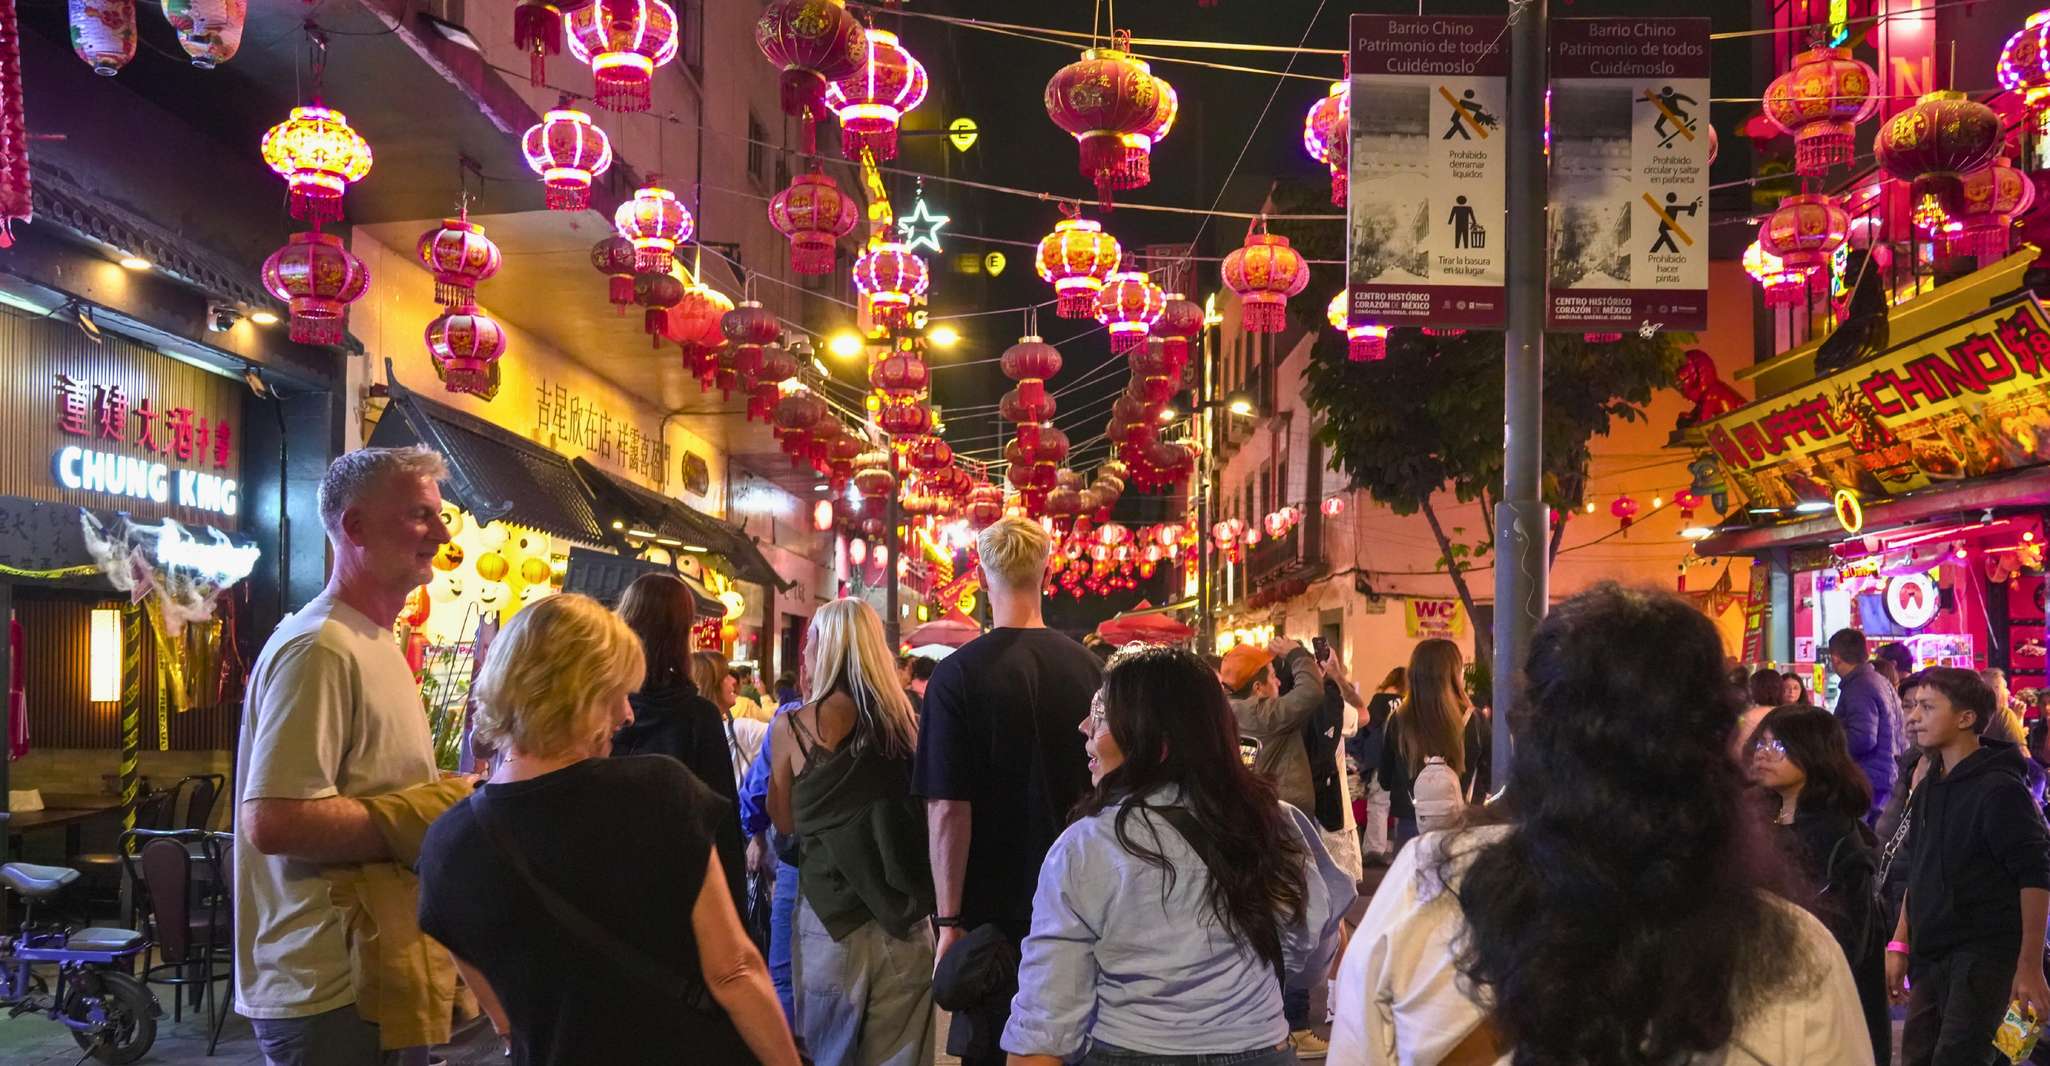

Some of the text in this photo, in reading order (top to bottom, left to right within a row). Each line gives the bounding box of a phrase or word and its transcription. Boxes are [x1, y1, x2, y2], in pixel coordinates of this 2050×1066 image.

[1388, 21, 1474, 35] Barrio Chino
[1589, 24, 1676, 37] Barrio Chino
[1358, 38, 1500, 54] Patrimonio de todos
[1559, 42, 1704, 56] Patrimonio de todos
[1386, 58, 1475, 74] Cuidémoslo
[1590, 60, 1675, 75] Cuidémoslo
[958, 124, 968, 140] E
[1449, 150, 1488, 160] Prohibido
[1652, 156, 1692, 165] Prohibido
[1643, 166, 1700, 177] circular y saltar
[1662, 176, 1695, 185] patineta
[990, 256, 998, 267] E
[1438, 256, 1491, 265] Tirar la basura
[1647, 255, 1687, 264] Prohibido
[1443, 267, 1485, 277] en su lugar
[1656, 264, 1679, 273] hacer
[1655, 275, 1681, 285] pintas
[1354, 292, 1430, 301] CENTRO HISTÓRICO
[1555, 296, 1632, 306] CENTRO HISTÓRICO
[1354, 300, 1390, 309] CORAZÓN
[1401, 301, 1430, 310] MÉXICO
[1555, 305, 1591, 314] CORAZÓN
[1602, 305, 1632, 314] MÉXICO
[1731, 393, 1842, 462] BUFFET
[1859, 331, 2016, 419] CHINO
[56, 446, 237, 516] CHUNG KING
[1414, 600, 1456, 618] WC
